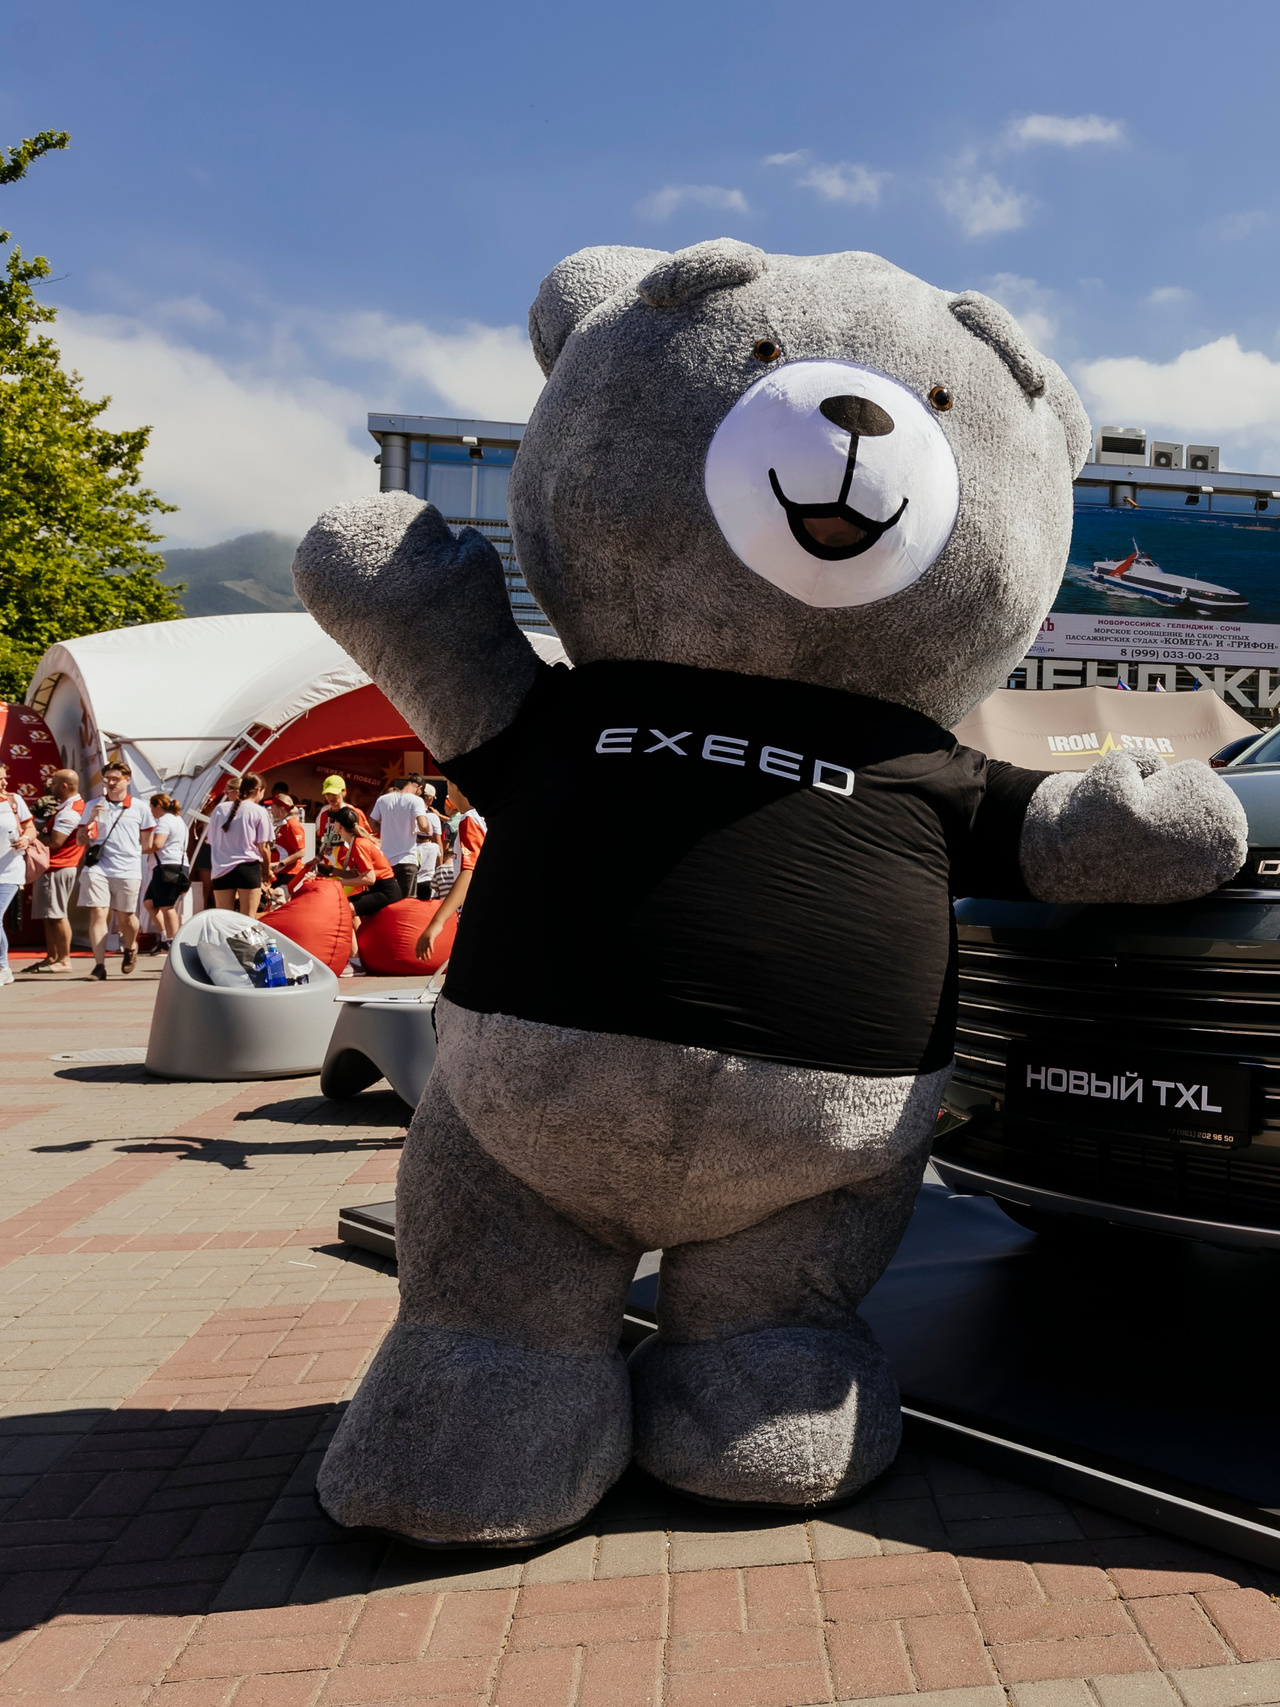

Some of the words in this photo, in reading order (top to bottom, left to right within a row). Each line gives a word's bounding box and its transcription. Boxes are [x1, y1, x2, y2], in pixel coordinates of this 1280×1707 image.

[1098, 619, 1161, 628] НОВОРОССИЙСК
[1167, 622, 1214, 631] ГЕЛЕНДЖИК
[1065, 634, 1131, 643] ПАССАЖИРСКИХ
[1132, 637, 1158, 645] СУДАХ
[1160, 637, 1213, 647] «КОМЕТА»
[1216, 640, 1224, 648] И
[1227, 641, 1278, 650] «ГРИФОН»
[1133, 629, 1183, 638] СООБЩЕНИЕ
[1197, 633, 1250, 641] СКОРОСТНЫХ
[1120, 648, 1127, 657] 8
[1131, 648, 1159, 660] (999)
[1163, 650, 1220, 661] 033-00-23
[1047, 732, 1100, 752] IRON
[1120, 734, 1174, 753] STAR
[595, 727, 856, 796] EXEED
[1026, 1064, 1143, 1104] НОВЫЙ
[1151, 1080, 1223, 1113] TXL
[1197, 1131, 1212, 1140] 202
[1212, 1133, 1223, 1141] 96
[1223, 1135, 1234, 1143] 50
